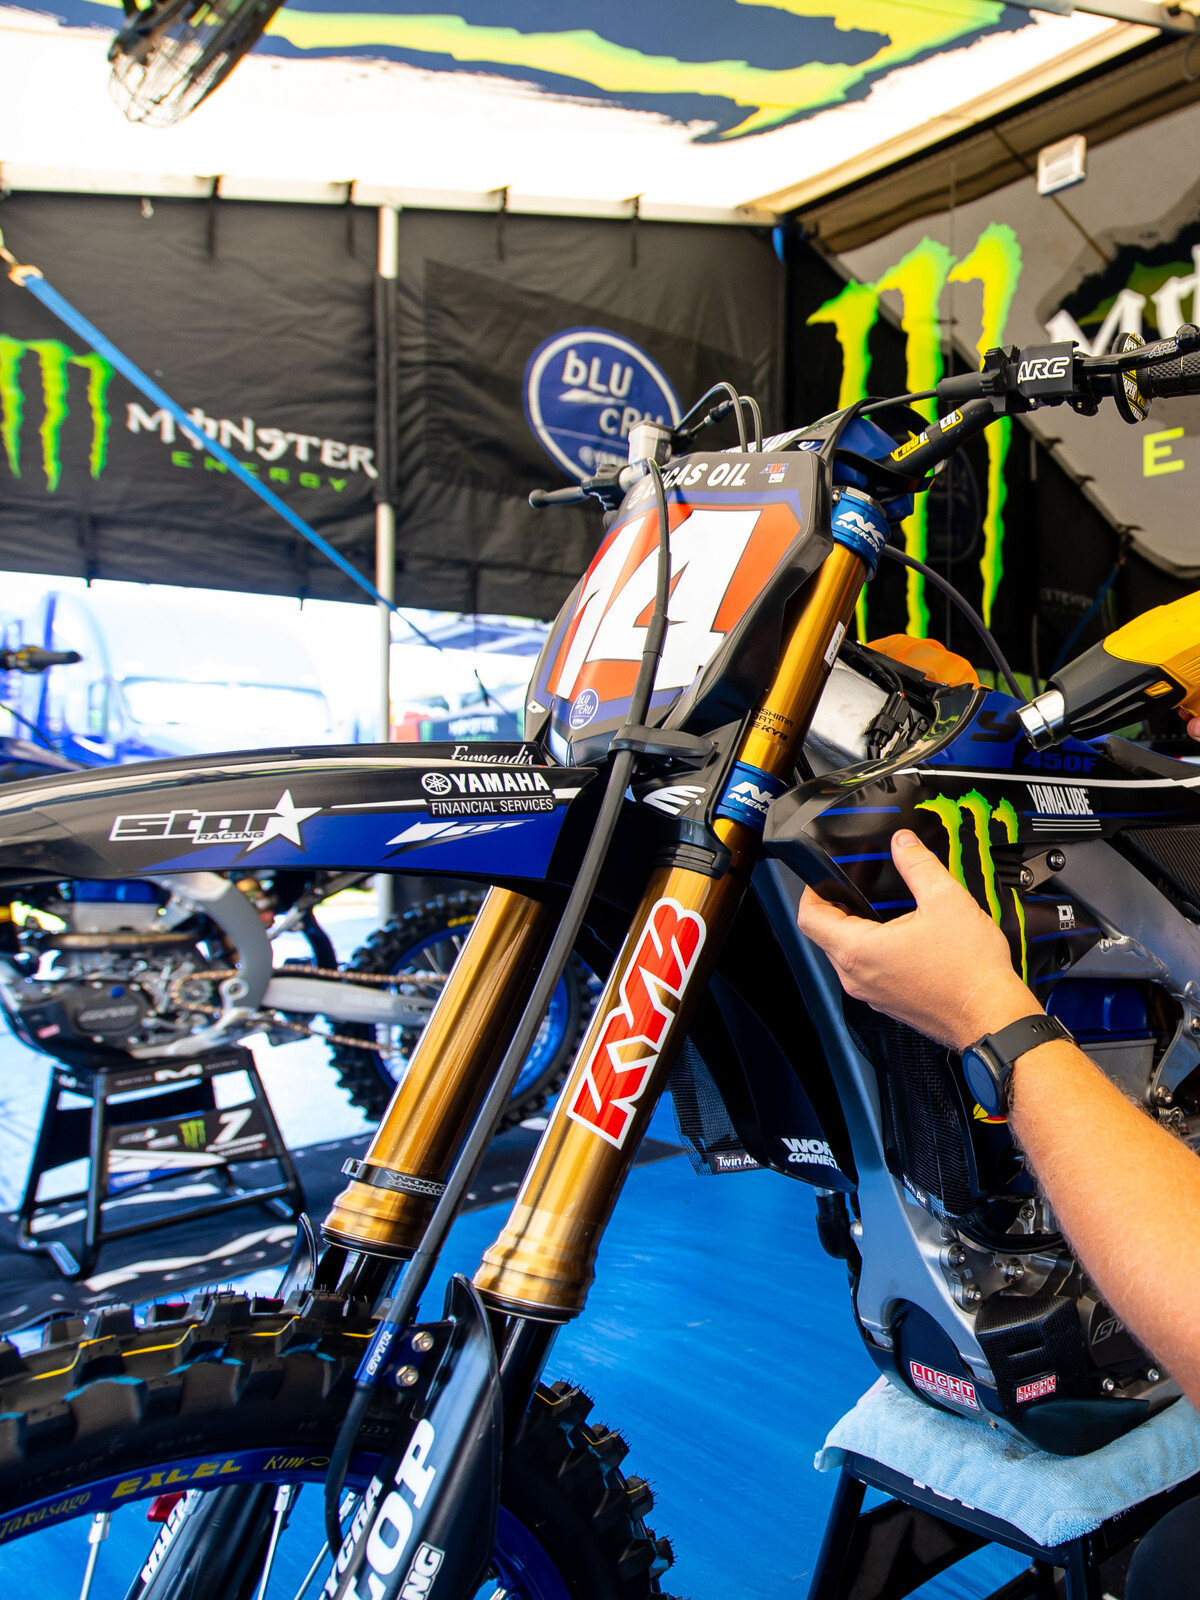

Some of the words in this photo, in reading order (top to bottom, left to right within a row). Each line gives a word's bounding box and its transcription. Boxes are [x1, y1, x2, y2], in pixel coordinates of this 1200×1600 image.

[1149, 341, 1177, 358] ARC
[1018, 357, 1070, 385] ARC
[126, 402, 379, 479] MONSTER
[707, 463, 750, 487] OIL
[1022, 751, 1097, 773] 450F
[449, 772, 550, 793] YAMAHA
[431, 801, 497, 815] FINANCIAL
[500, 798, 553, 812] SERVICES
[1026, 784, 1094, 816] YAMALUBE
[199, 831, 264, 841] RACING
[566, 897, 707, 1150] KYB
[781, 1137, 836, 1158] WOR
[716, 1156, 741, 1168] Twin
[910, 1361, 975, 1399] LIGHT
[1017, 1375, 1056, 1394] LIGHT
[914, 1378, 980, 1410] SPEED
[1017, 1385, 1056, 1402] SPEED
